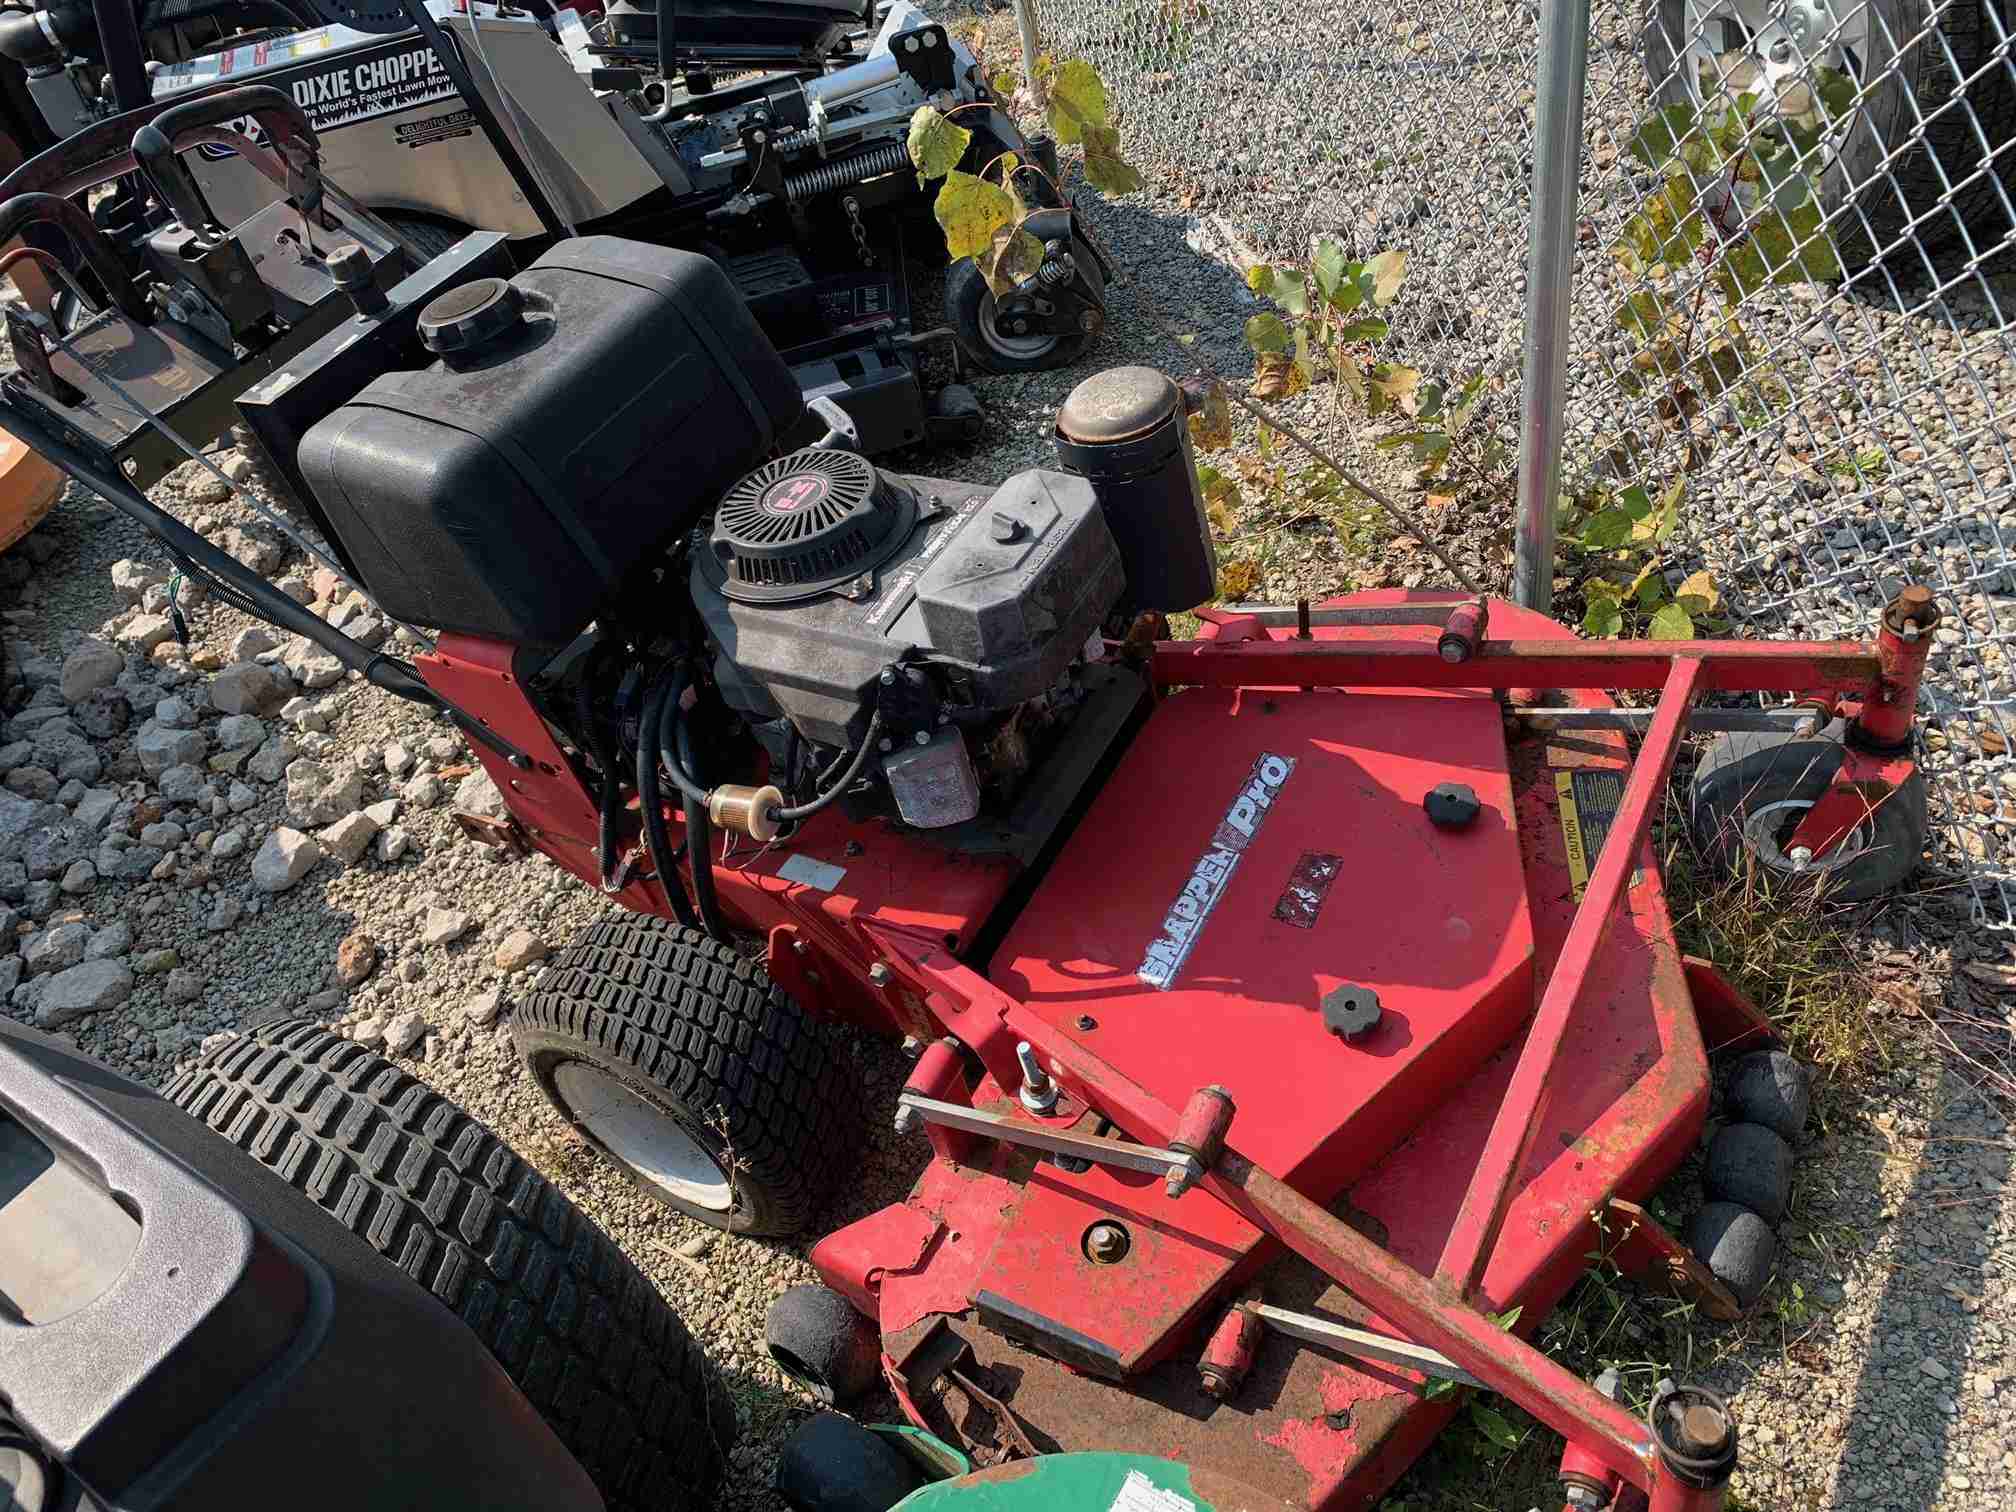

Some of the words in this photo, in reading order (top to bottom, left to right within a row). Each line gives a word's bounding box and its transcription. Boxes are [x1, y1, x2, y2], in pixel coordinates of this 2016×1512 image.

[292, 67, 351, 107] DIXIE
[355, 47, 445, 91] CHOPPE
[319, 96, 358, 115] World's
[360, 85, 396, 104] Fastest
[399, 80, 426, 94] Lawn
[1565, 819, 1581, 860] CAUTION
